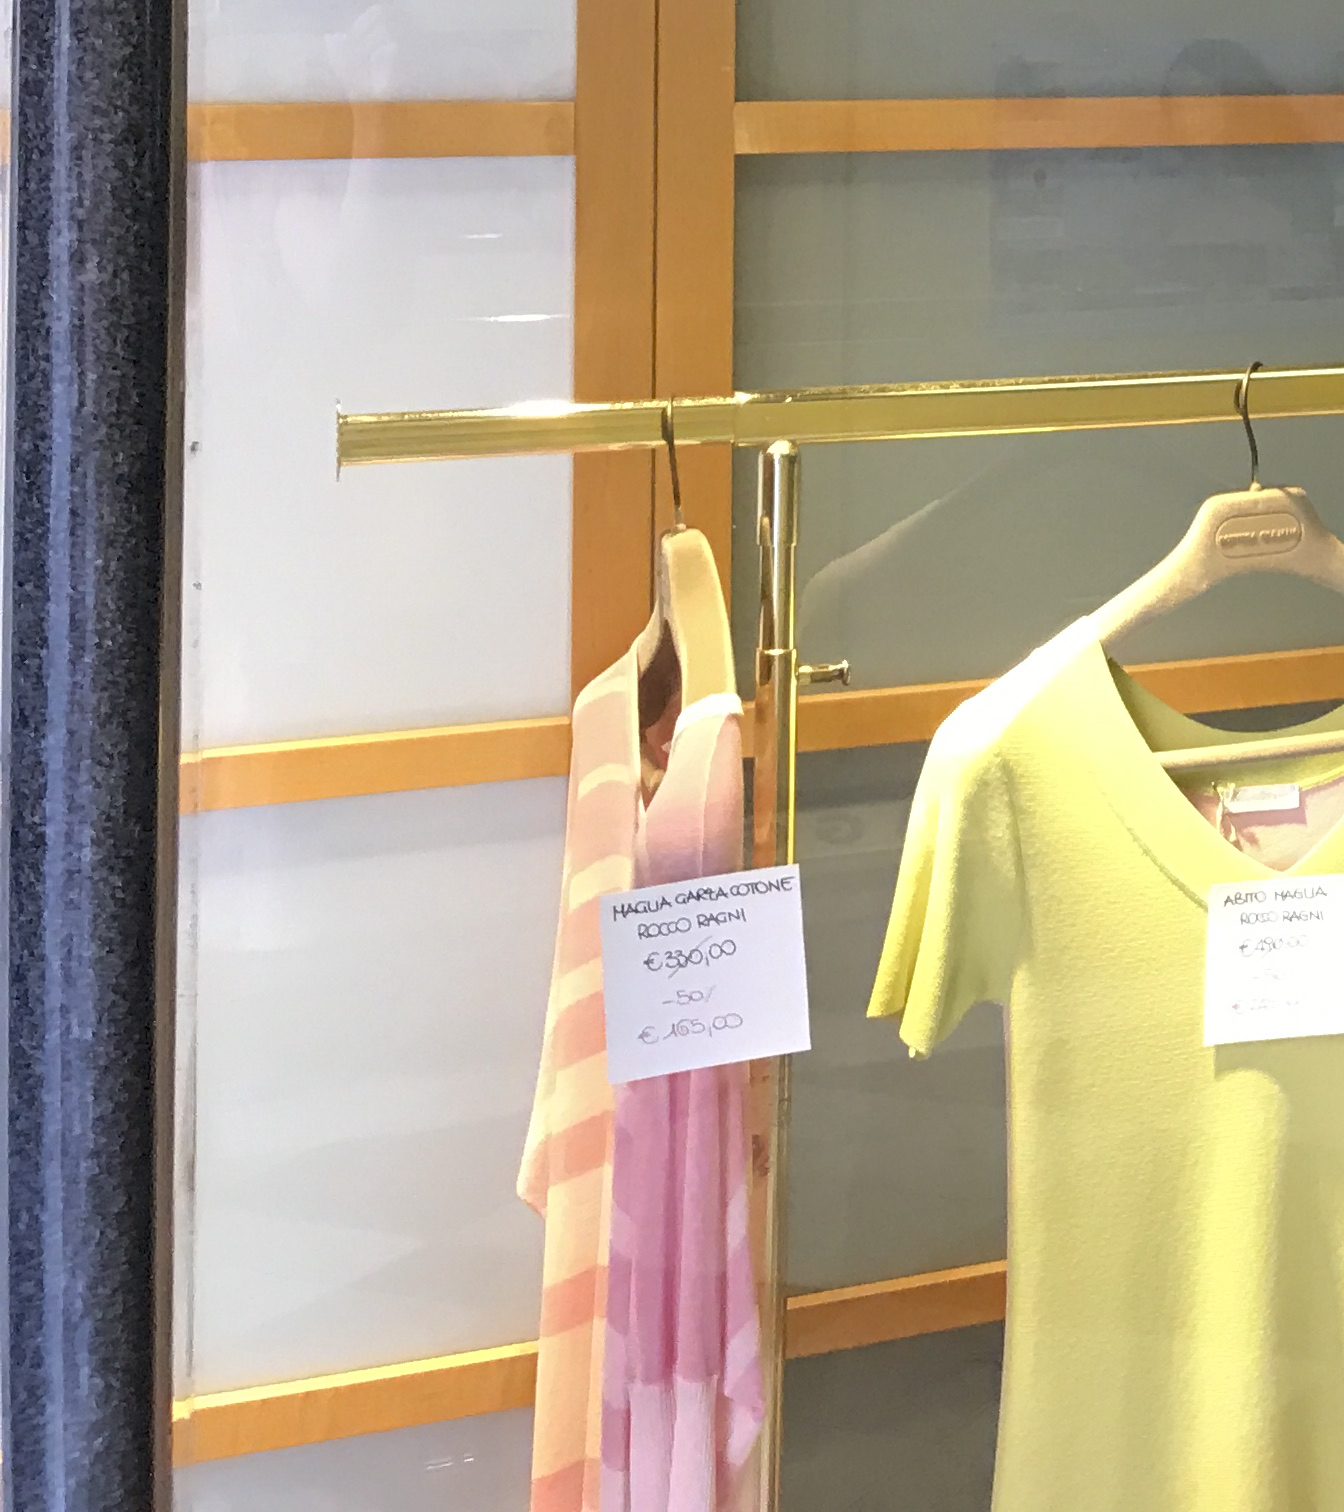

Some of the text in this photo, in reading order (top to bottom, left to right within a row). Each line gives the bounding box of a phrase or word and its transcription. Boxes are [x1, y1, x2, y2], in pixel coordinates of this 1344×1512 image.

[674, 886, 729, 906] GARZA
[729, 876, 796, 897] COTONE
[1223, 890, 1268, 907] ABITO
[637, 907, 748, 940] ROCCO RAGNI
[1239, 910, 1324, 925] ROCCO RAGNI
